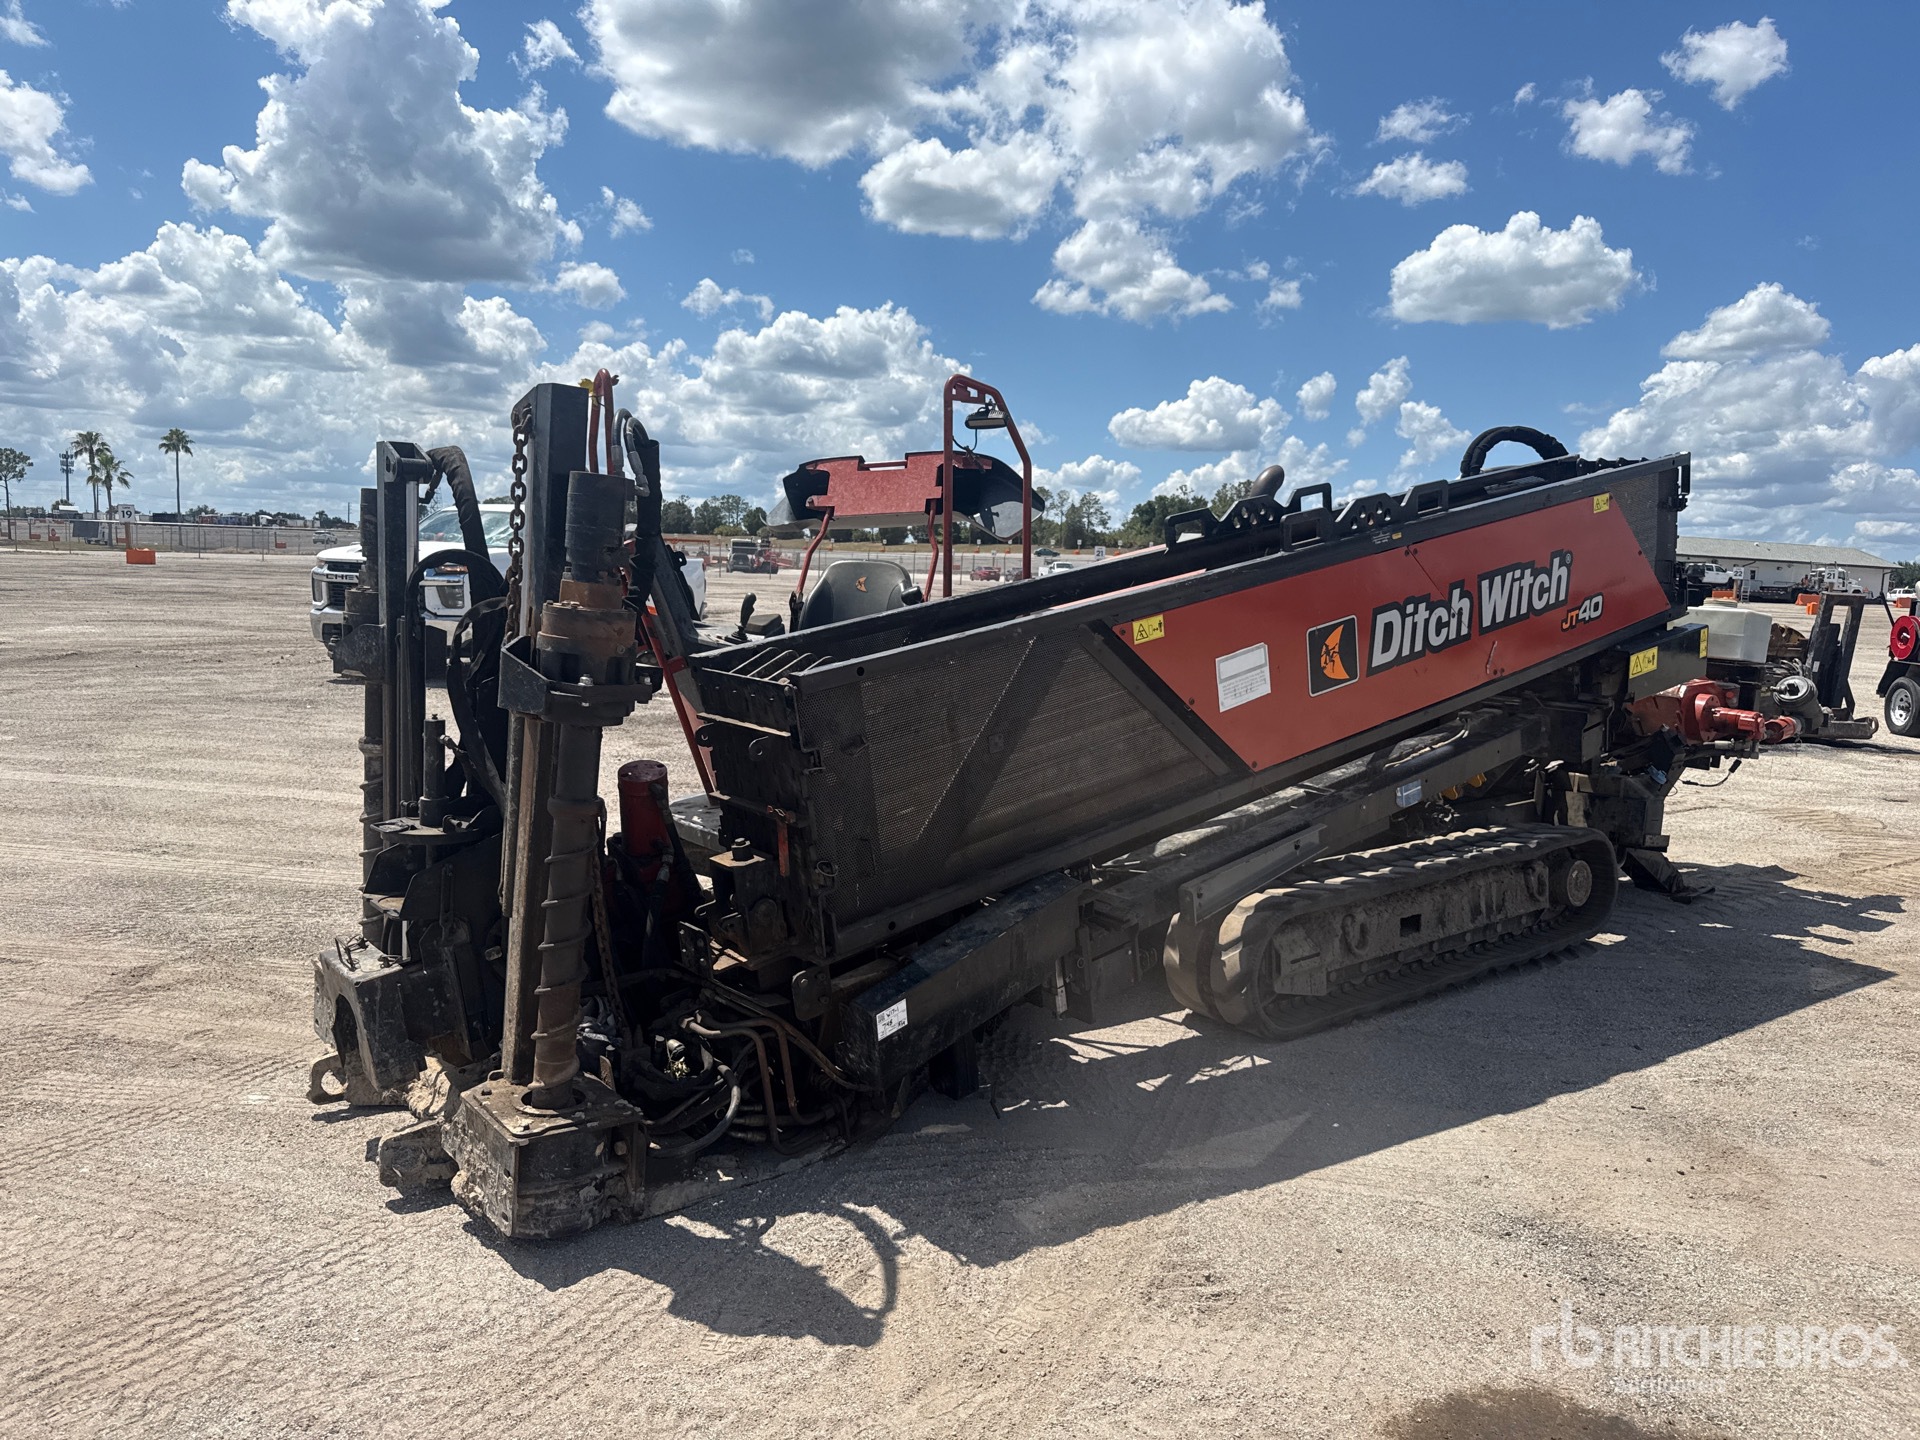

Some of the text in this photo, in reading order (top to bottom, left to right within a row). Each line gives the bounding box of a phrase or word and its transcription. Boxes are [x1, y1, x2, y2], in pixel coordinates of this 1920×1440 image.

[120, 510, 133, 519] 19
[1826, 572, 1836, 580] 21
[1562, 594, 1604, 630] JT40
[1371, 587, 1471, 668] Ditch
